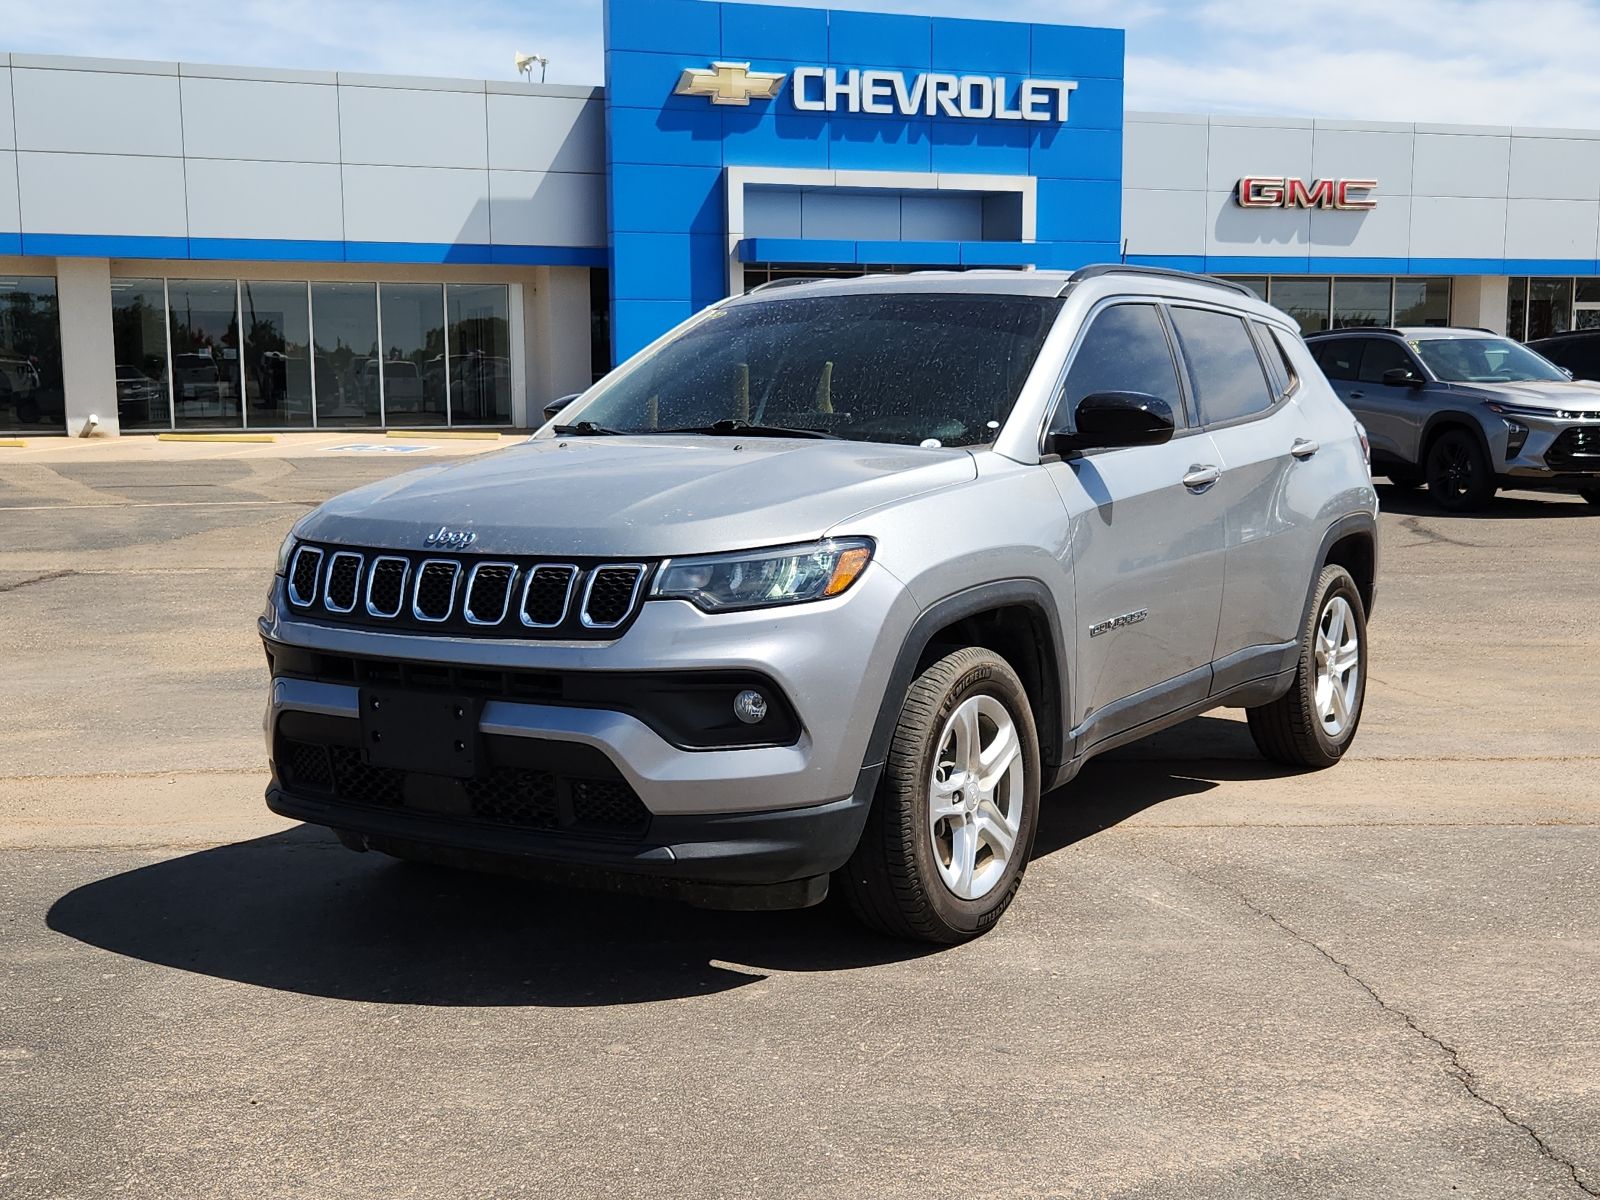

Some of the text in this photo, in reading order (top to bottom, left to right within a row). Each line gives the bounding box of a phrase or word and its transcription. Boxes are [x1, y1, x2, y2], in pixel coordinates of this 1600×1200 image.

[793, 67, 1078, 122] CHEVROLET
[1238, 175, 1377, 210] GMC
[426, 526, 476, 548] Jeep
